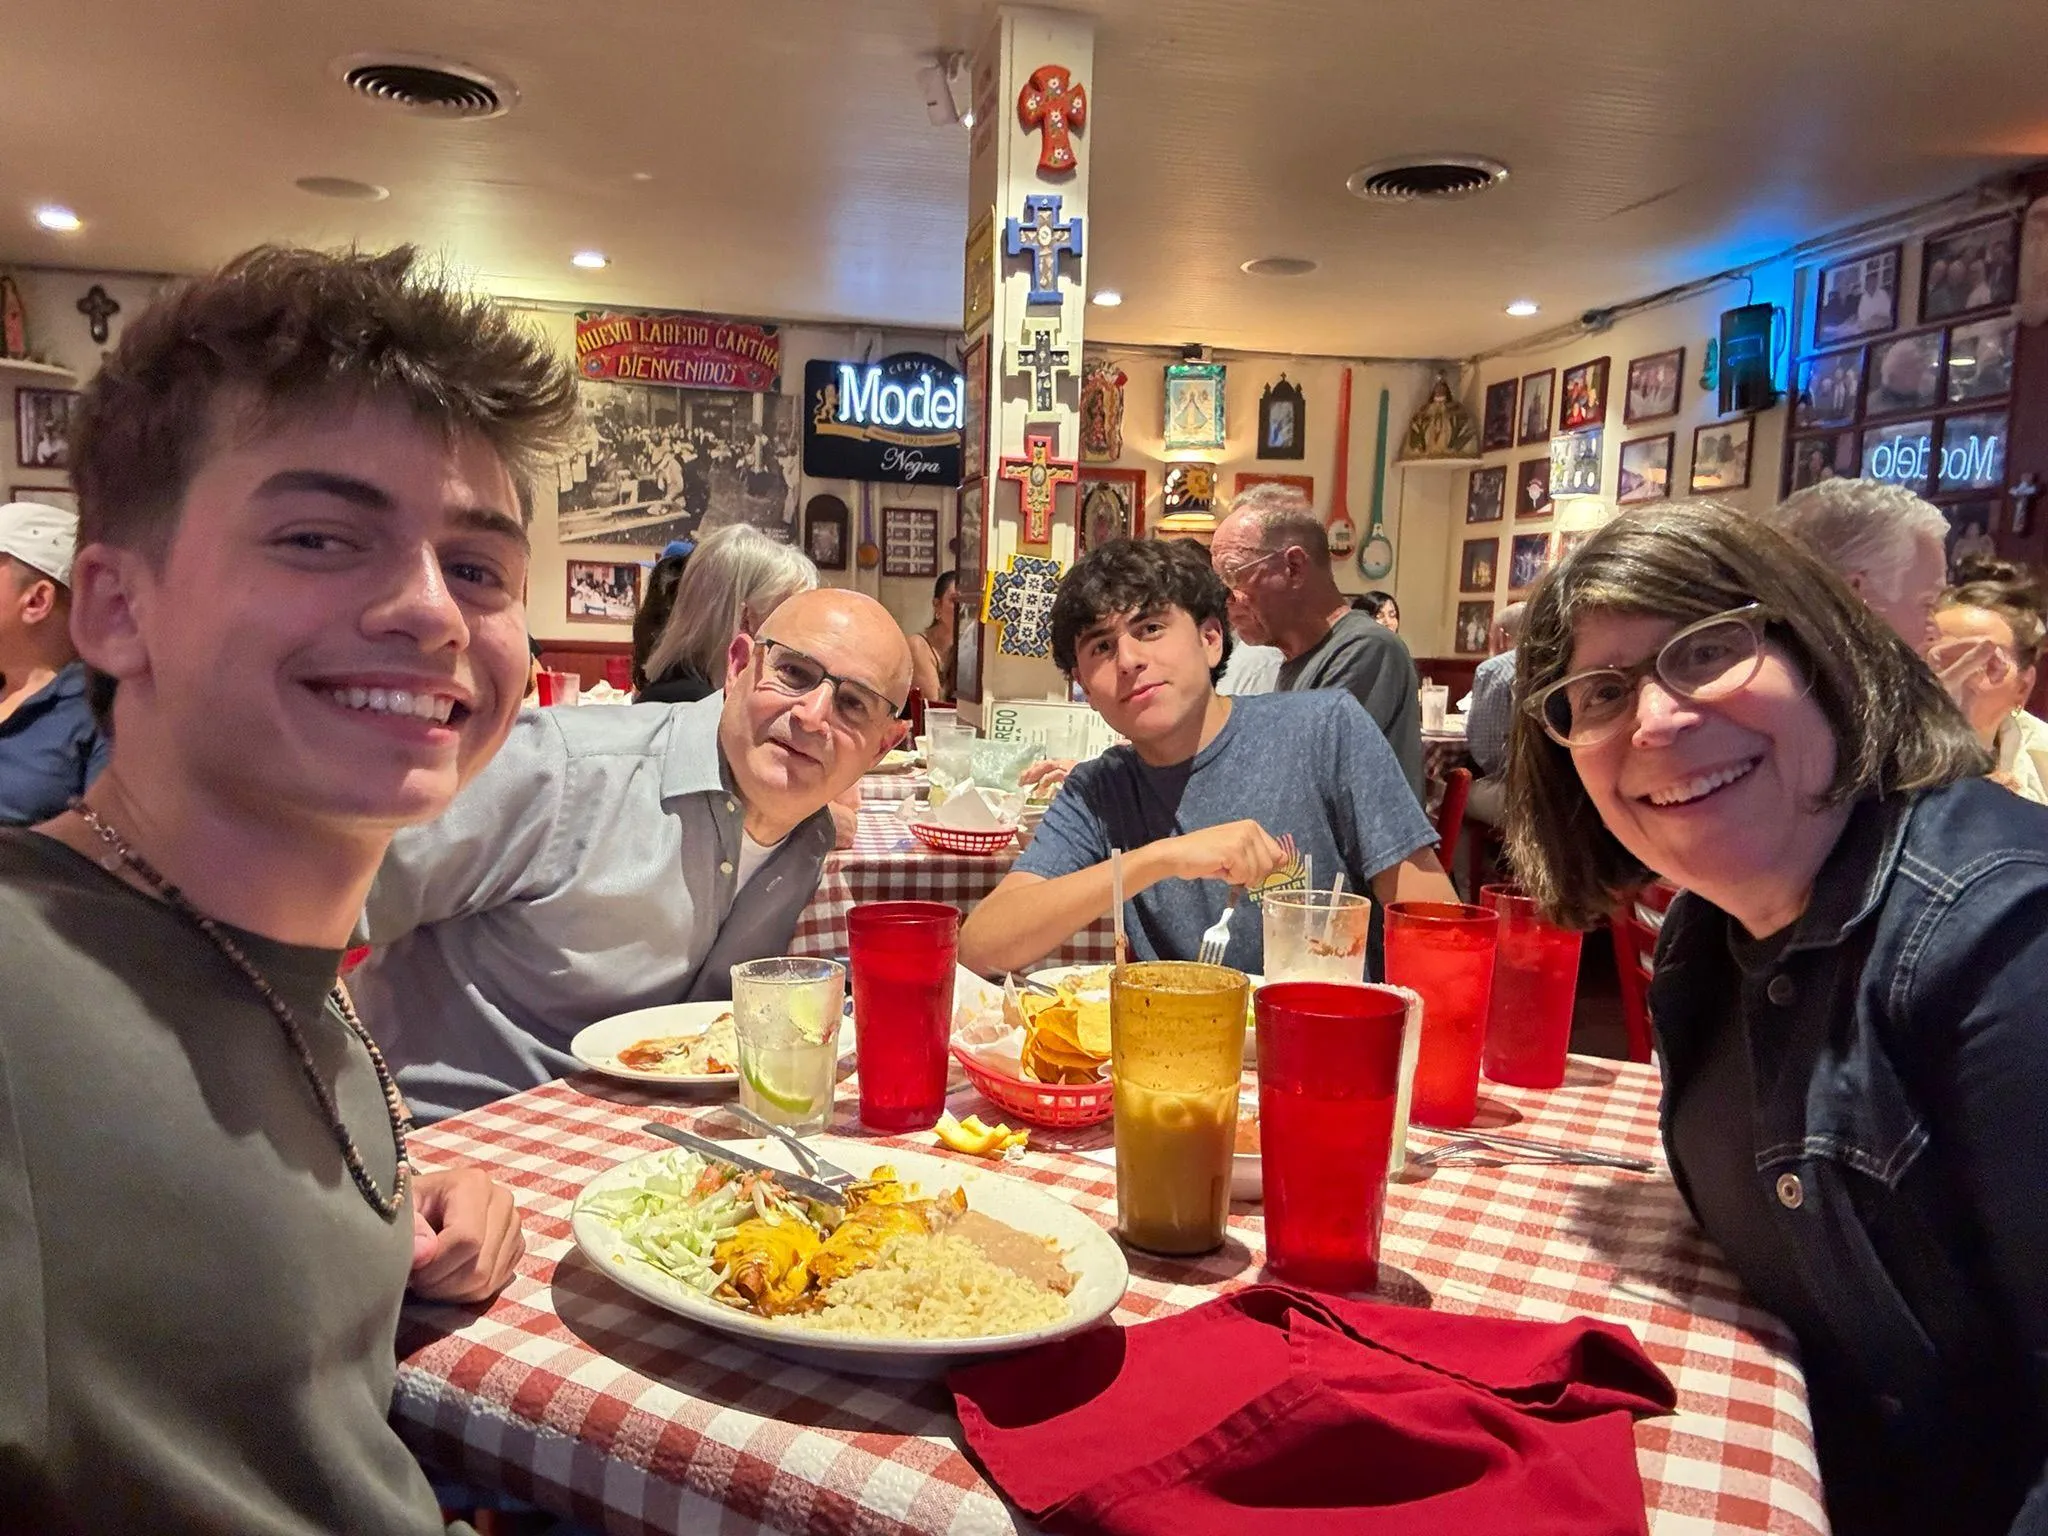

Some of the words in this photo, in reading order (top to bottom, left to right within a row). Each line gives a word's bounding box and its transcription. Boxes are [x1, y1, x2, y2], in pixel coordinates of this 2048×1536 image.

[577, 321, 632, 354] NUEVO
[640, 321, 708, 346] LAREDO
[715, 328, 780, 370] CANTINA
[618, 354, 738, 384] BIENVENIDOS
[889, 361, 943, 379] CERVEZA
[837, 365, 966, 430] Model
[880, 447, 941, 481] Negra
